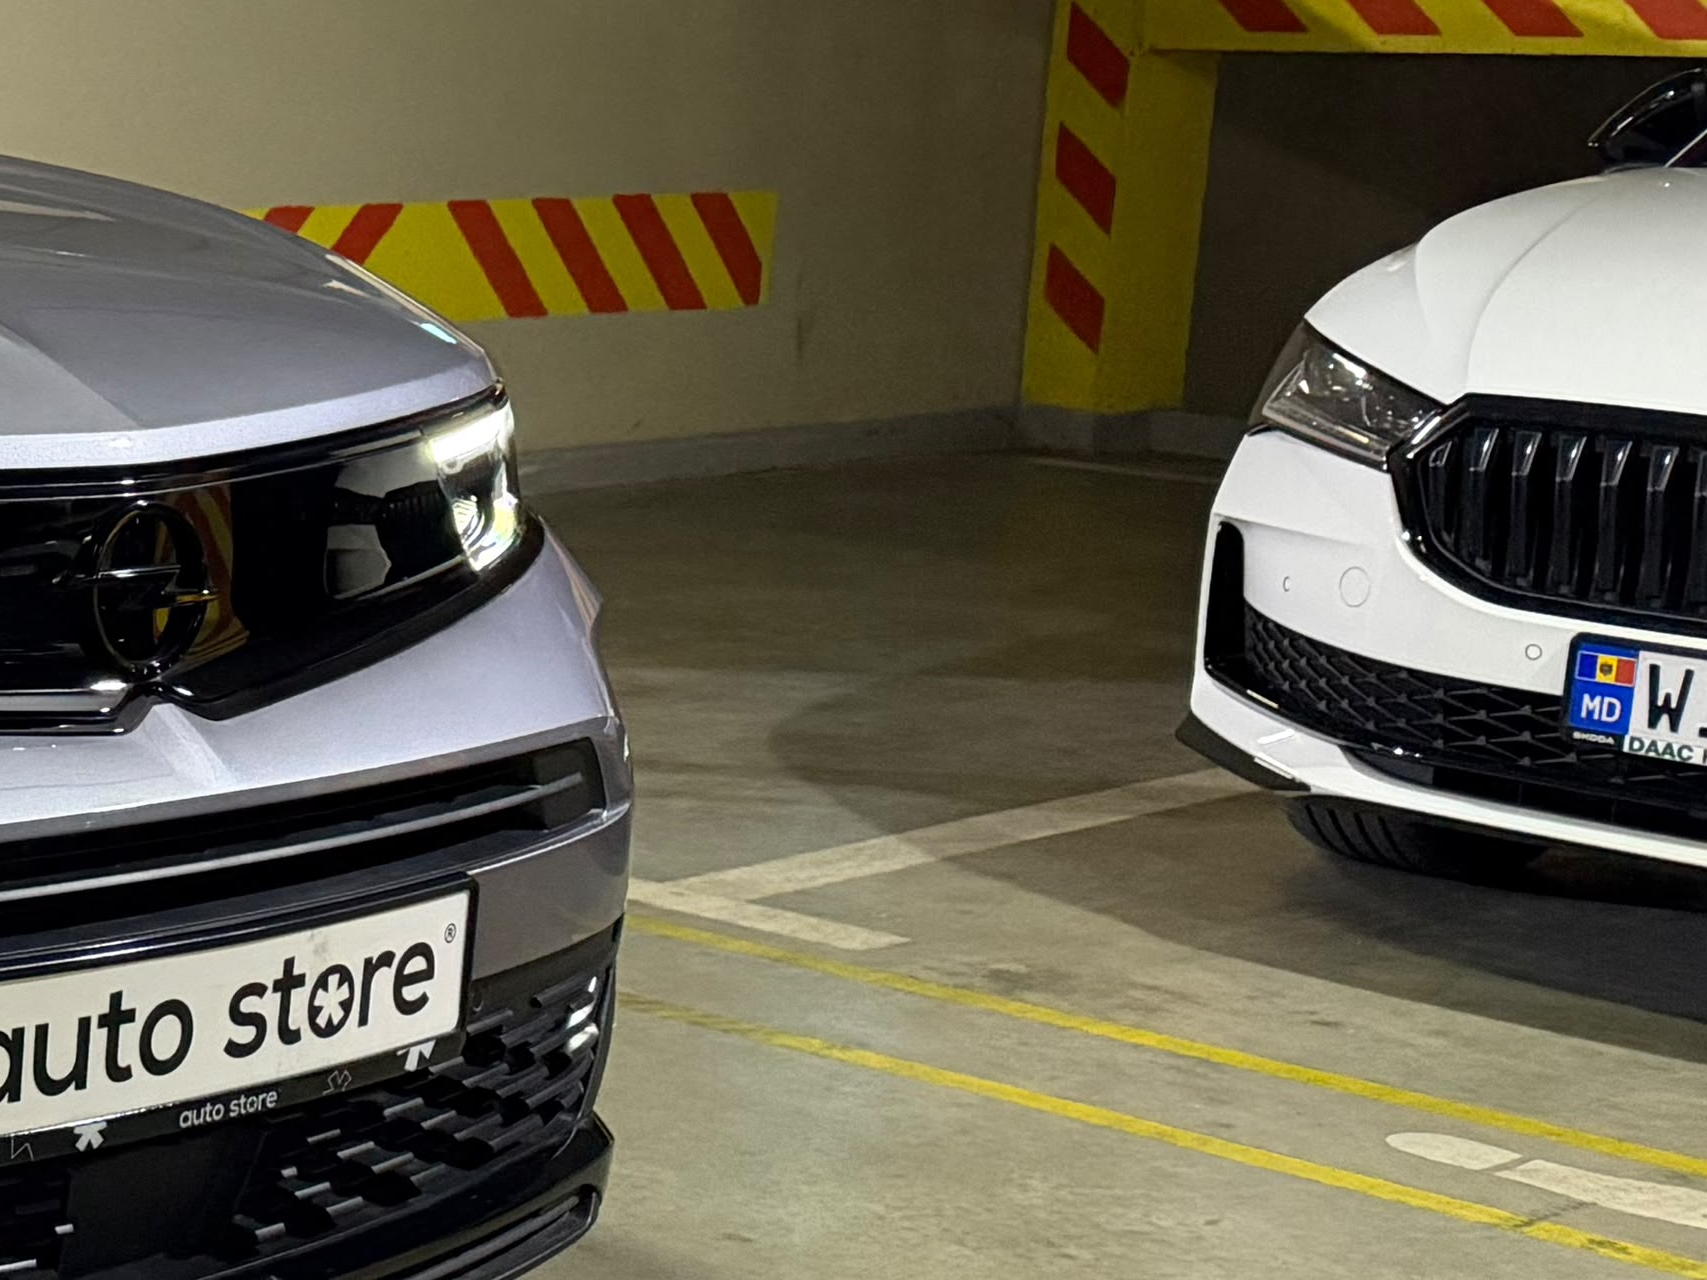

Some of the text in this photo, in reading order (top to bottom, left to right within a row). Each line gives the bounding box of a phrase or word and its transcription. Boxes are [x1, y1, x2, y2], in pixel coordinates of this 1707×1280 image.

[1580, 693, 1622, 723] MD
[1647, 663, 1707, 734] W
[1628, 735, 1695, 762] DAAC
[224, 941, 436, 1059] store
[179, 1091, 277, 1128] auto store
